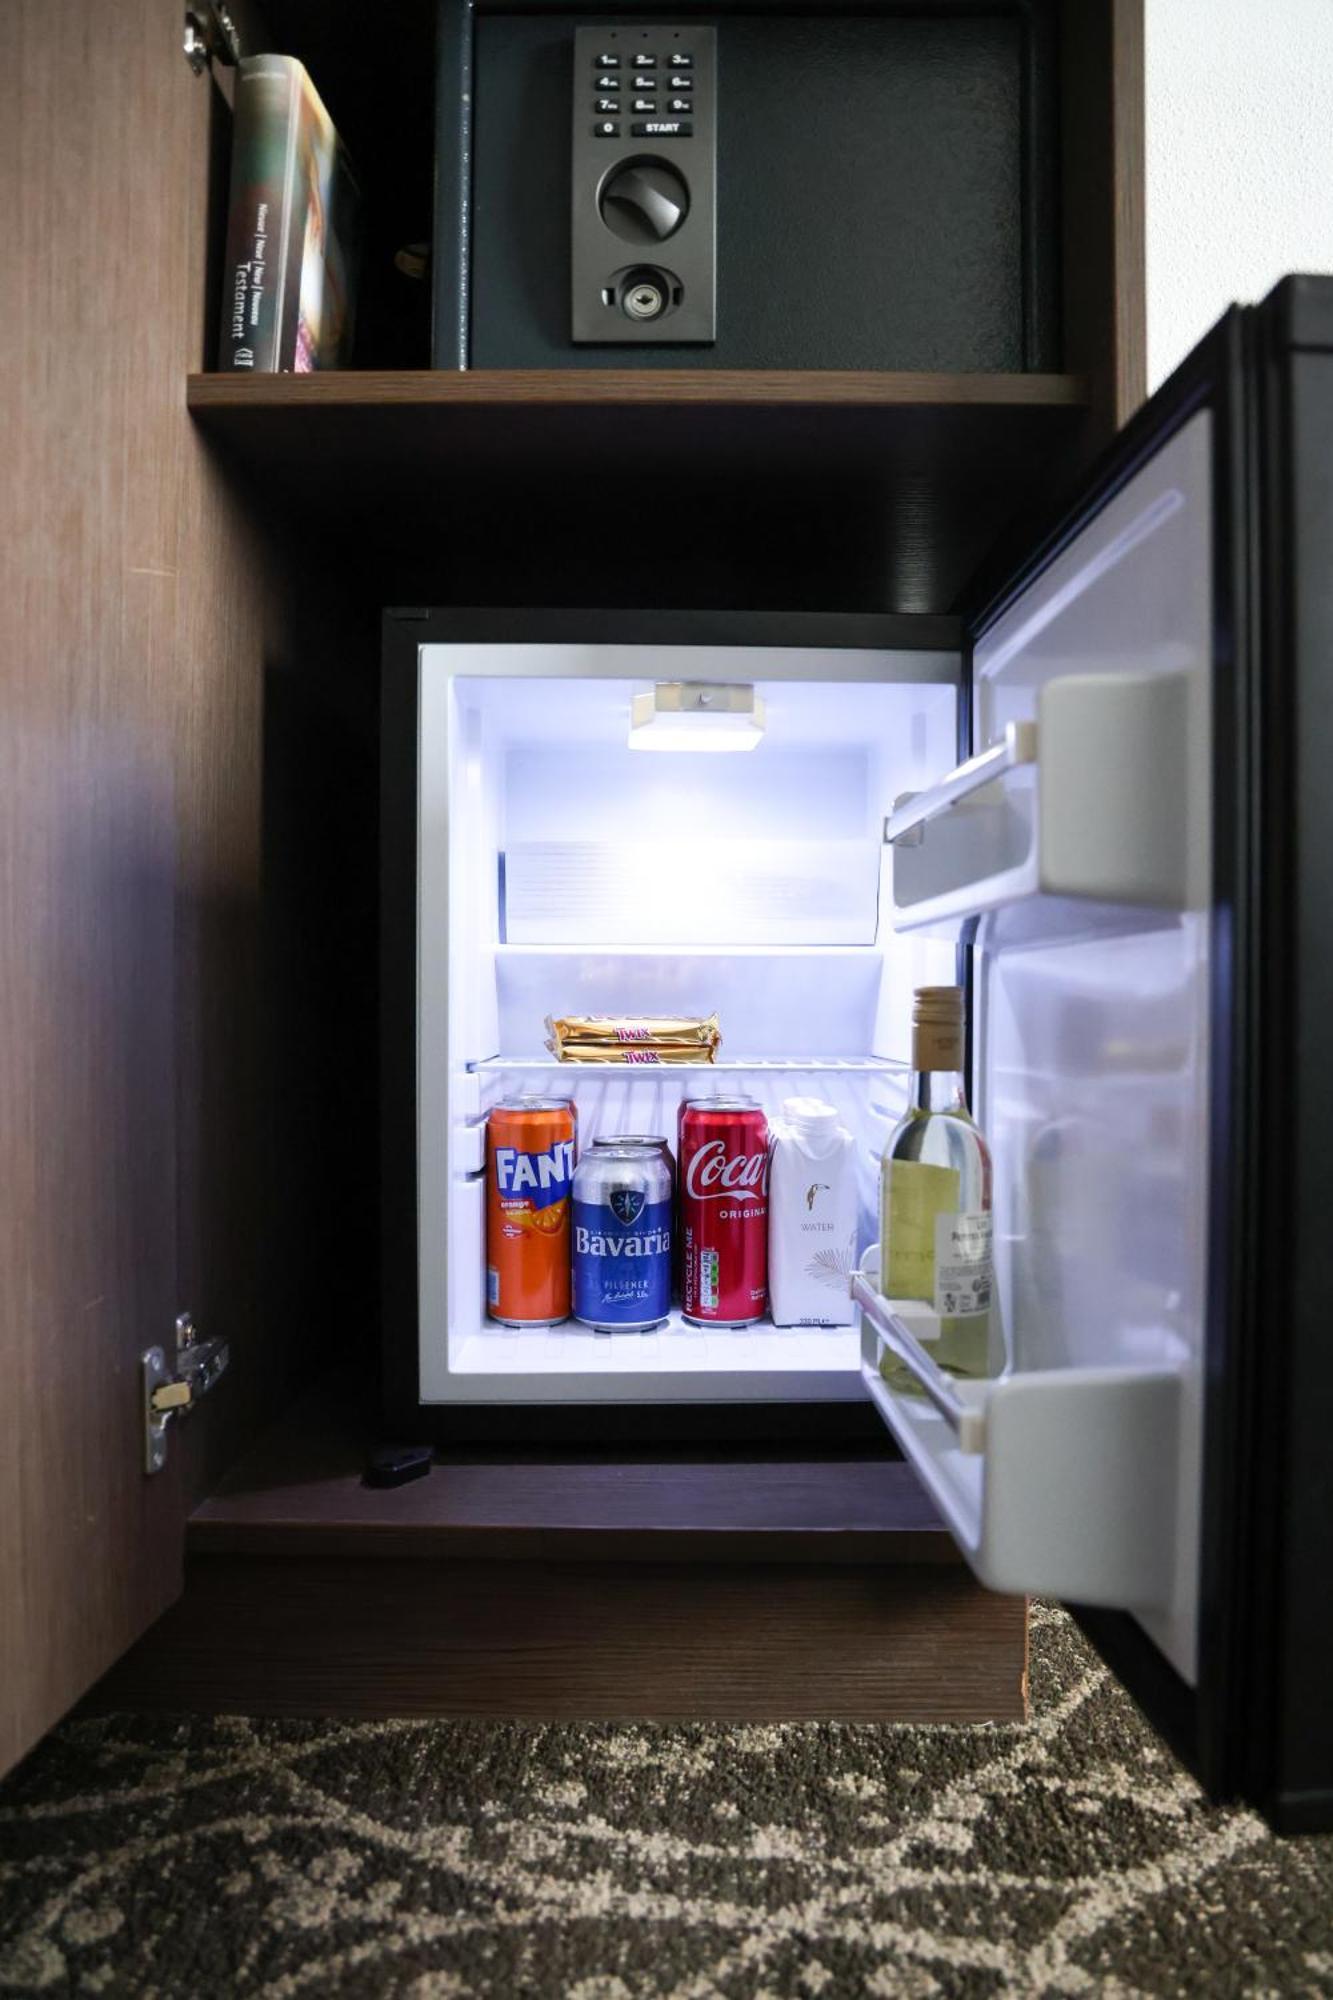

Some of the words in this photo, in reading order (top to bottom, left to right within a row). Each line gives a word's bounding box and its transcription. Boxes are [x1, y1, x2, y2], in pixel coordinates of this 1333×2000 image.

[645, 123, 680, 132] START
[232, 262, 250, 339] Testament
[496, 1141, 574, 1191] FANT
[575, 1226, 670, 1257] Bavaria
[800, 1223, 835, 1232] WATER
